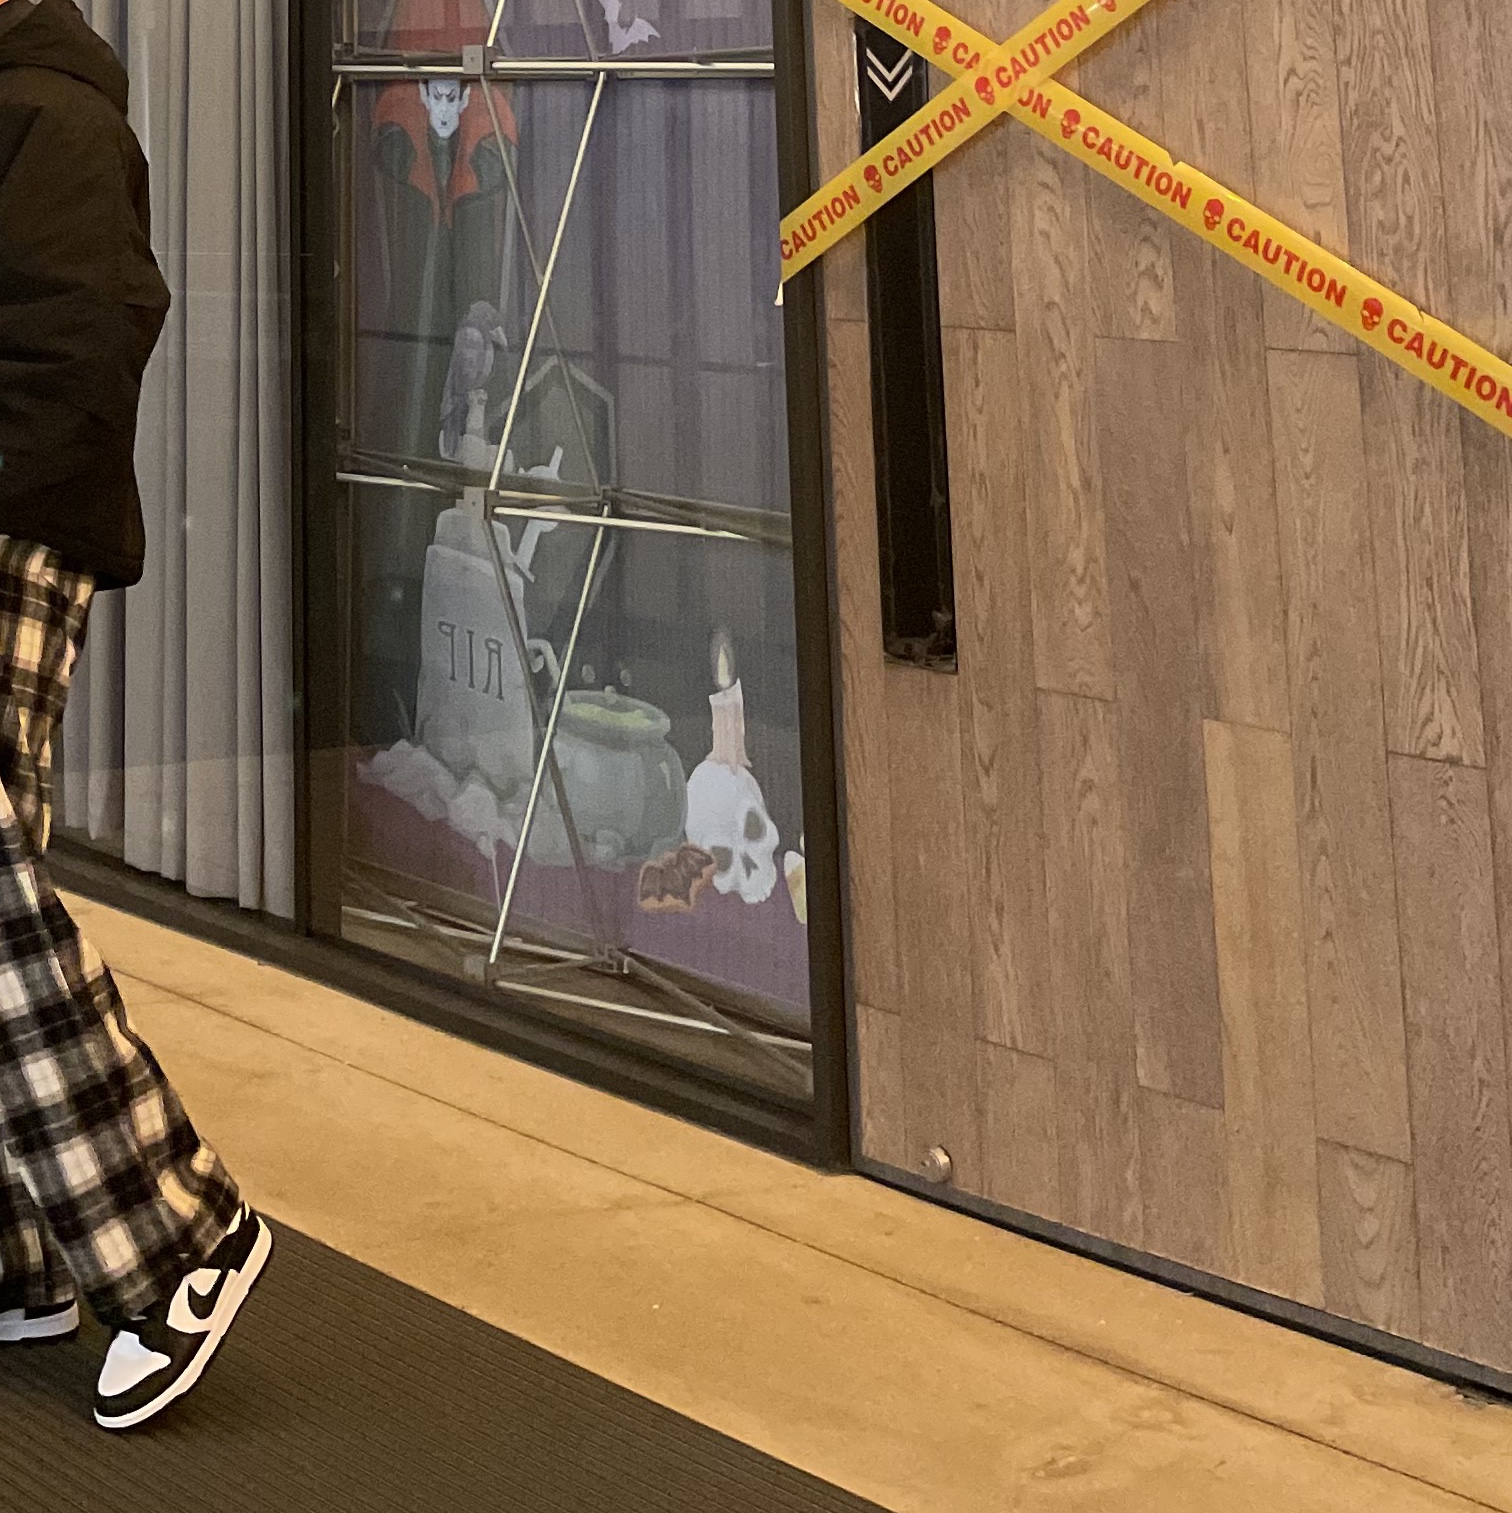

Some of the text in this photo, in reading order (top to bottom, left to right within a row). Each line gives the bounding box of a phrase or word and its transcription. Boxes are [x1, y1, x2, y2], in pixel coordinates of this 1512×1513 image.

[779, 184, 861, 261] CAUTION
[882, 97, 972, 178] CAUTION
[994, 4, 1092, 90] CAUTION
[1081, 125, 1194, 210] CAUTION
[1225, 217, 1348, 309] CAUTION
[1387, 318, 1512, 419] CAUTION
